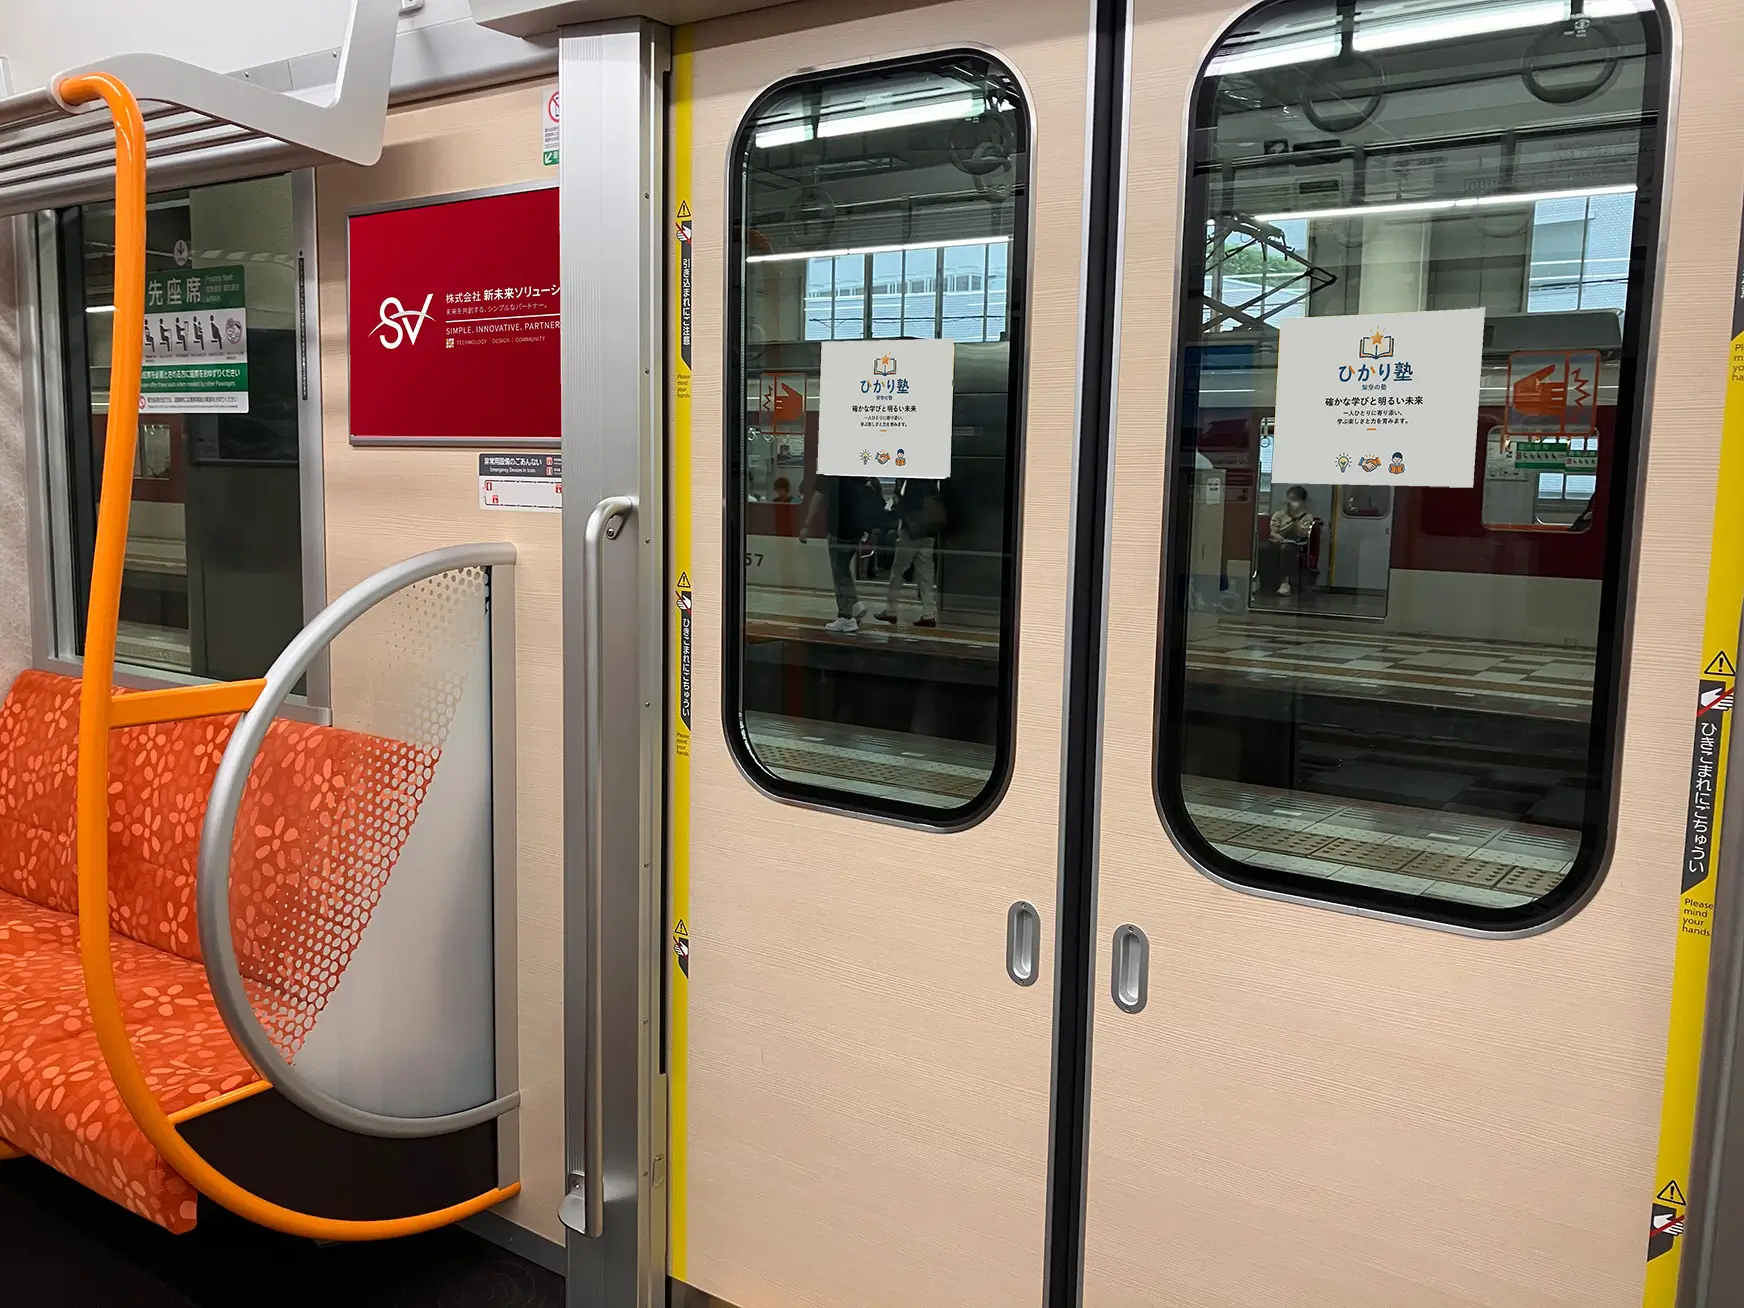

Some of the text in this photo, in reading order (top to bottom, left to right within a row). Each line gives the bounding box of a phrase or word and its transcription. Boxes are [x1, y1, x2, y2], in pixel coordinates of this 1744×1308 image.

[445, 291, 482, 304] 株式会社
[682, 258, 691, 346] 引き込まれにご注意
[445, 325, 474, 335] SIMPLE.
[475, 323, 523, 333] INNOVATIVE.
[456, 338, 487, 346] TECHNOLOGY
[515, 335, 546, 343] COMMUNITY
[1338, 361, 1414, 382] ひかり塾
[860, 378, 909, 394] ひかり塾
[1324, 395, 1424, 407] 確かな学びと明るい未来
[851, 404, 917, 413] 確かな学びと明るい未来
[1336, 417, 1409, 425] 学ぶ楽しさと力を育みます。
[682, 618, 690, 717] ひきこまれにごちゅうい
[1688, 722, 1718, 873] ひきこまれにごちゅうい
[1684, 898, 1714, 910] Please
[1683, 908, 1708, 918] mind
[1682, 917, 1704, 926] your
[1682, 924, 1710, 936] hands
